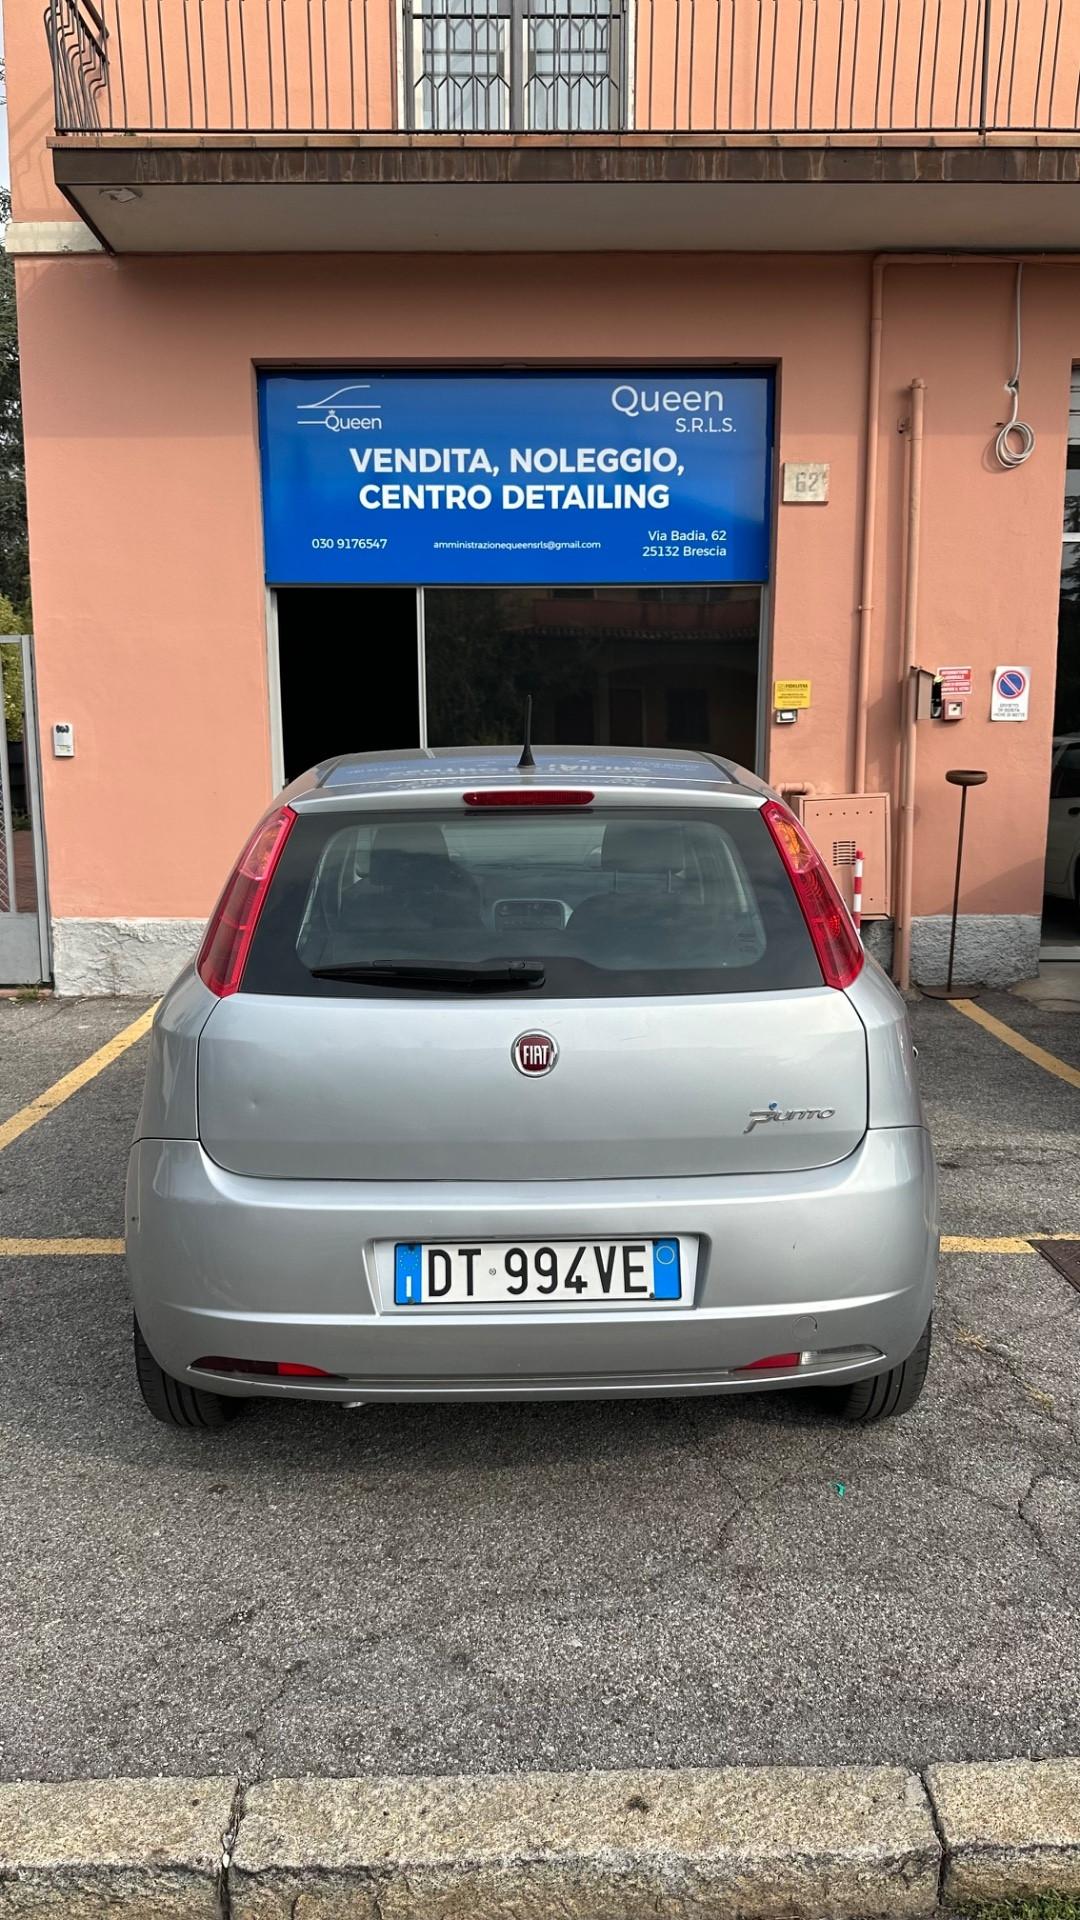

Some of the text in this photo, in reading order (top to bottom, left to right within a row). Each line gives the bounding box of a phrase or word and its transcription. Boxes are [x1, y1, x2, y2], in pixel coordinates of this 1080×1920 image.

[612, 385, 725, 417] Queen
[325, 415, 383, 432] Queen
[675, 417, 737, 433] S.R.L.S.
[350, 447, 685, 476] VENDITA, NOLEGGIO,
[795, 471, 819, 492] 62
[359, 484, 670, 510] CENTRO DETAILING
[311, 538, 388, 549] 030 9176547
[648, 529, 727, 542] Via Badia, 62
[433, 540, 601, 550] amministrazionequeensrls@gmail.com
[642, 545, 727, 557] 25132 Brescia
[523, 1045, 549, 1065] FIAT
[428, 1245, 648, 1297] DT 994VE
